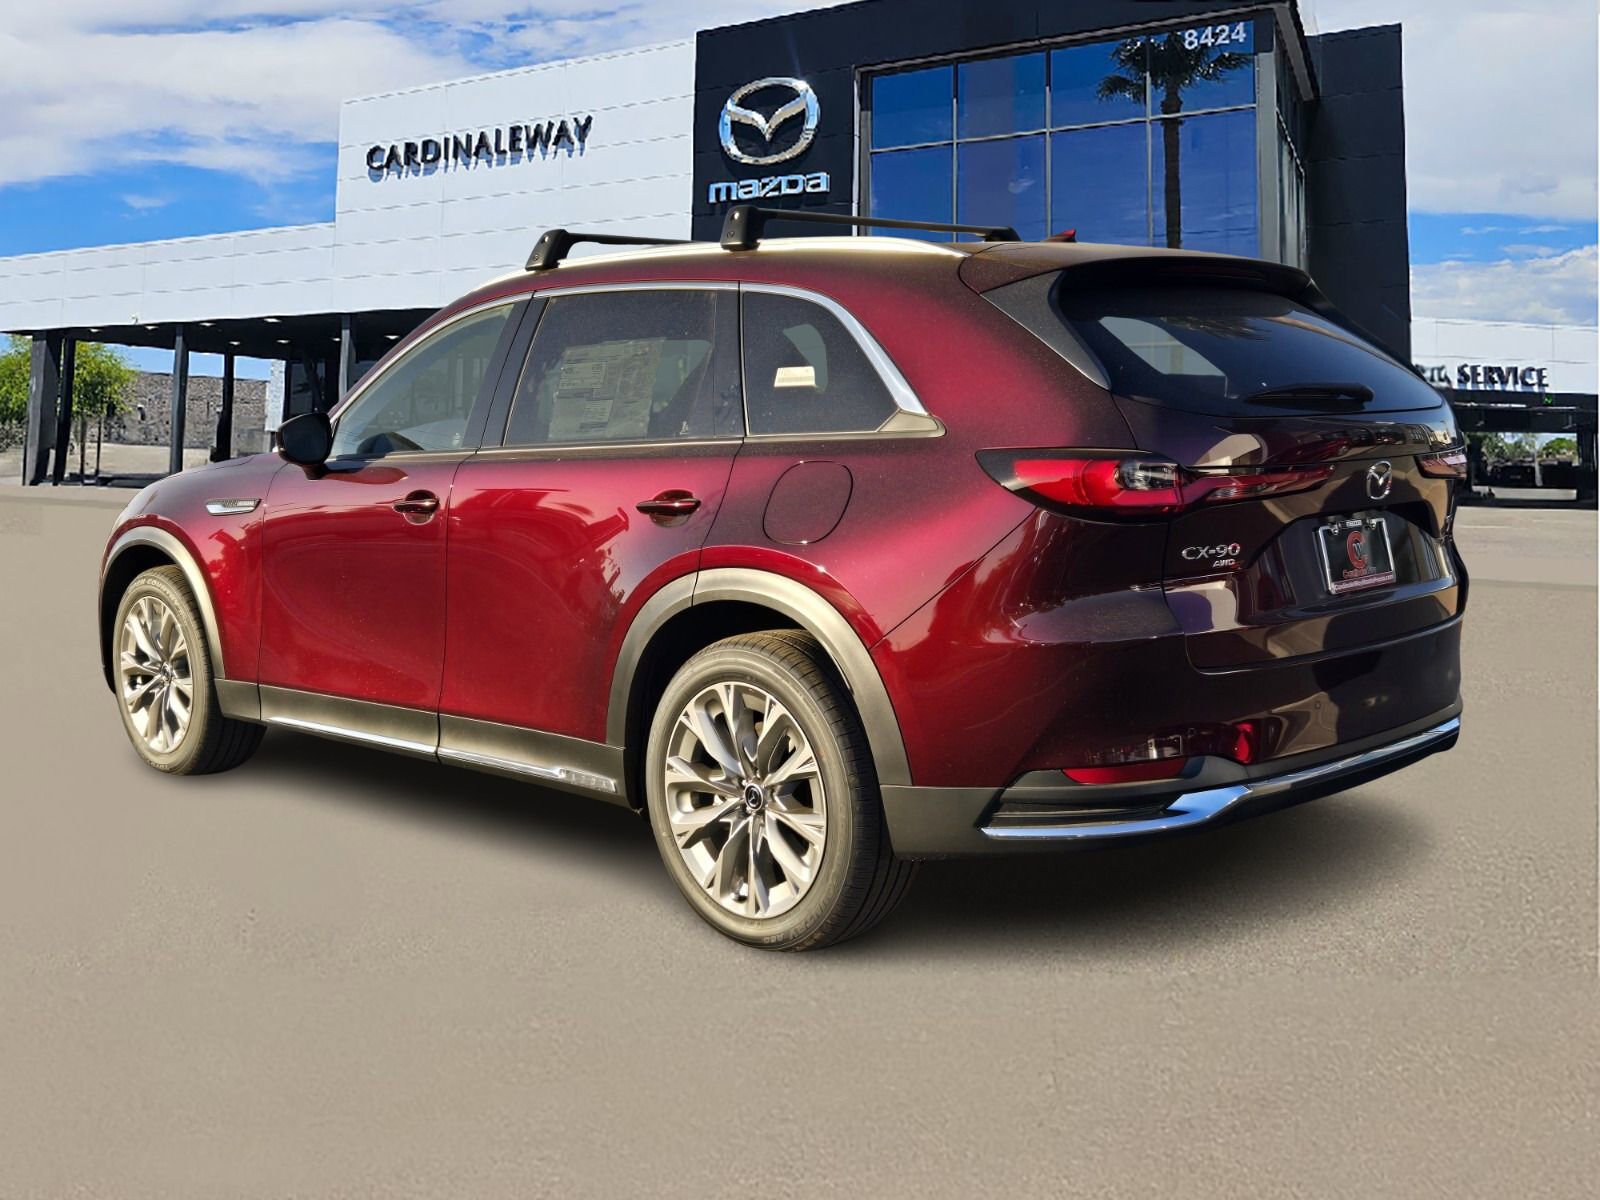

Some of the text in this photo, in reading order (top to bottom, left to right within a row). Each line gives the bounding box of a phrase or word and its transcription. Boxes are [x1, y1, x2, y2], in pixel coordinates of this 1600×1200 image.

[1184, 22, 1246, 50] 8424
[366, 114, 593, 170] CARDINALEWAY
[1457, 363, 1549, 388] SERVICE
[1181, 542, 1241, 560] CX-90
[1212, 558, 1237, 568] AWD
